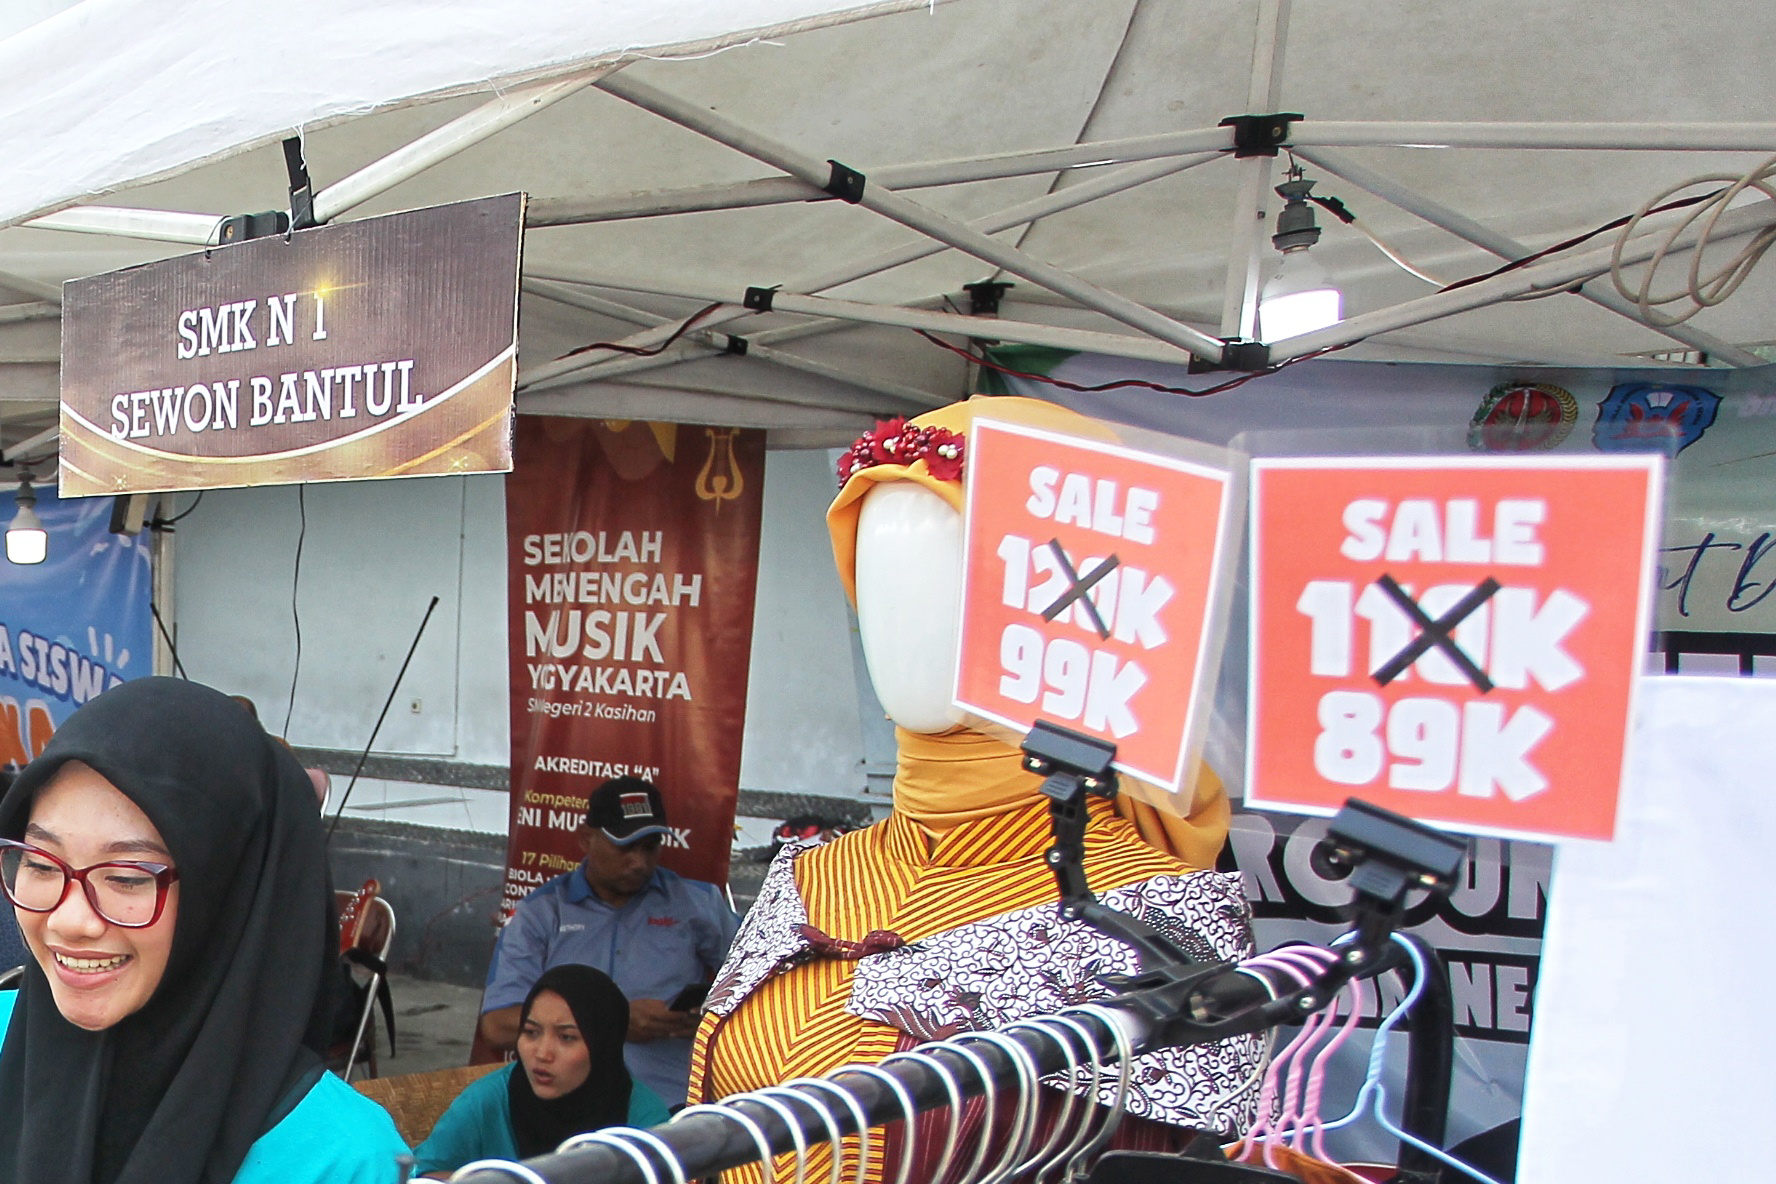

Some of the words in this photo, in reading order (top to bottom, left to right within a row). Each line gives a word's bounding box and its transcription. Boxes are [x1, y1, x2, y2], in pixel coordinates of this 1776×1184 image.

[177, 299, 257, 361] SMK
[266, 292, 297, 347] N
[110, 379, 241, 441] SEWON
[250, 359, 424, 427] BANTUL
[1025, 464, 1161, 546] SALE
[1339, 497, 1547, 567] SALE
[524, 530, 663, 566] SEKOLAH
[525, 571, 702, 608] MENENGAH
[18, 629, 124, 704] SISW
[524, 609, 668, 664] MUSIK
[526, 663, 693, 701] YGYAKARTA
[998, 622, 1149, 740] 99K
[594, 702, 656, 723] Kasihan
[534, 755, 629, 779] AKREDITASI
[1313, 689, 1555, 803] 89K
[521, 850, 535, 866] 17
